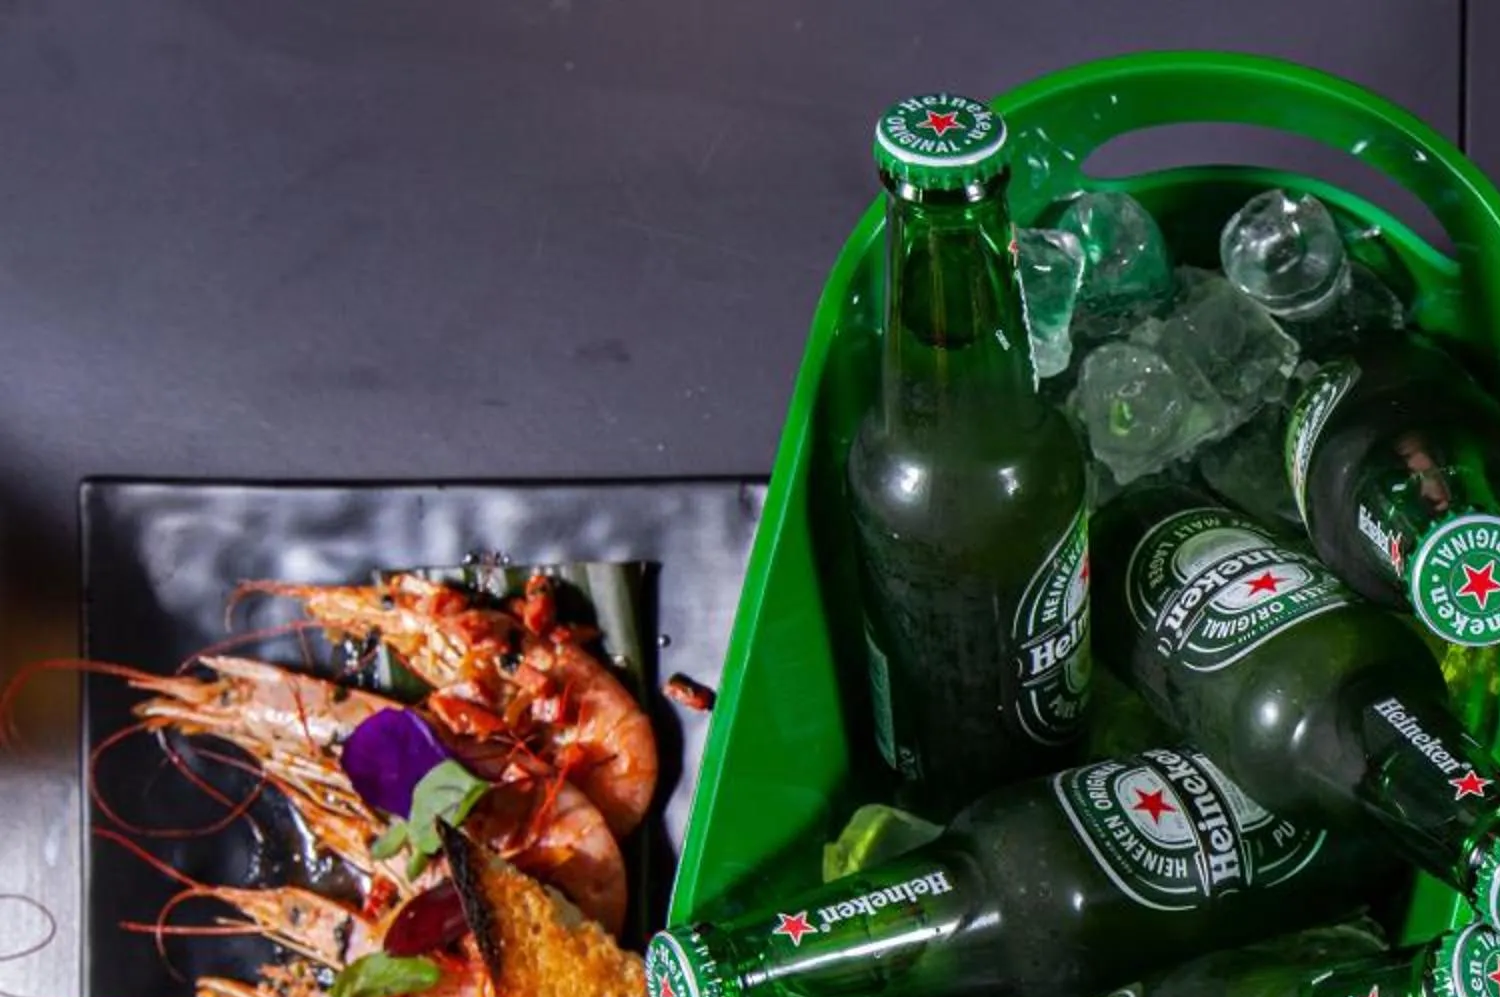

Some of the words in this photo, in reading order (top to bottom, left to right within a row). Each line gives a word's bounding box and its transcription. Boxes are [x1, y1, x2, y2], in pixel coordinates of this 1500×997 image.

[887, 115, 961, 153] ORIGINAL
[900, 93, 994, 141] Heineken
[1173, 515, 1221, 541] MALT
[1201, 602, 1286, 640] ORIGINAL
[1372, 697, 1462, 775] Heineken
[1103, 813, 1189, 879] HEINEKEN
[817, 871, 953, 926] Heineken
